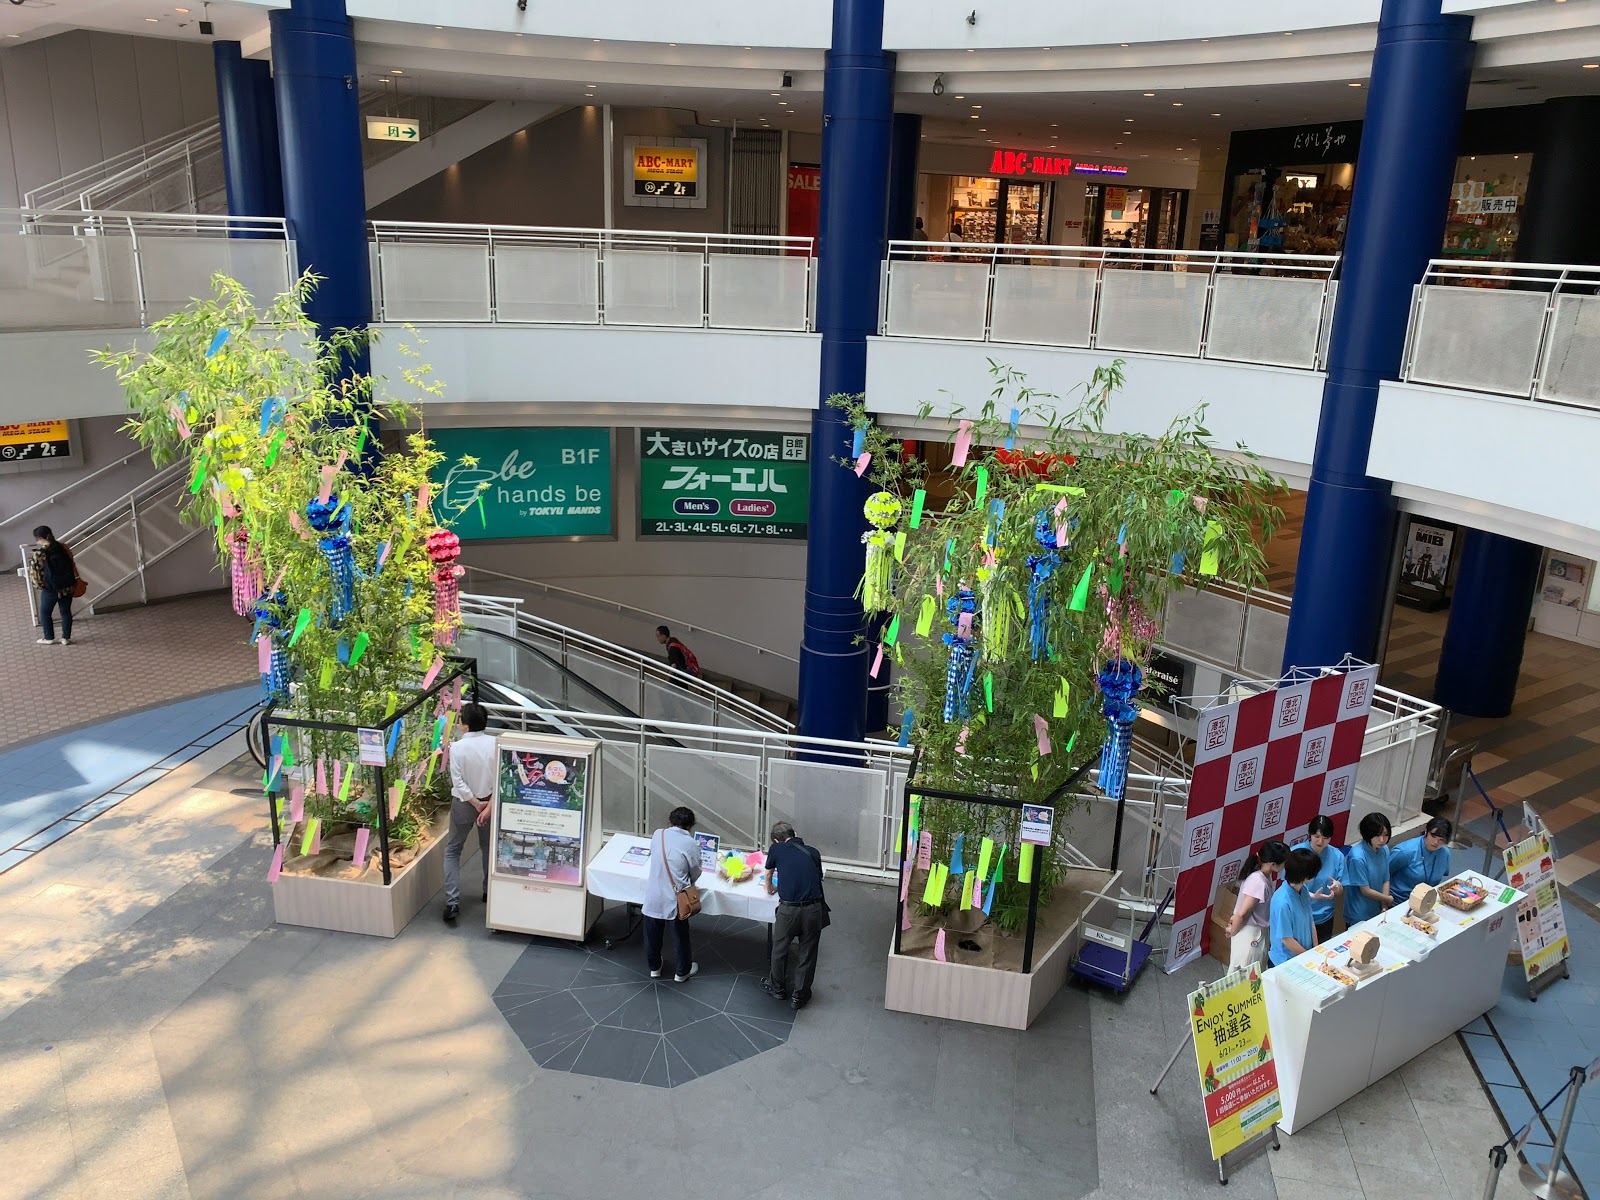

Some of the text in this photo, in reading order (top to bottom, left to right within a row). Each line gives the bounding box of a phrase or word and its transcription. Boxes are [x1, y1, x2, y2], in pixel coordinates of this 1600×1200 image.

[637, 155, 694, 168] ABC-MART
[990, 150, 1072, 175] ABC-MART
[673, 182, 686, 195] 2F
[41, 442, 57, 456] 2F
[646, 431, 780, 460] 大きいサイズの店
[561, 448, 601, 465] B1F
[661, 466, 789, 493] フォーエル
[497, 485, 602, 503] hands be
[519, 506, 602, 517] by TOKYU HANDS
[683, 501, 711, 511] Men's
[737, 503, 770, 513] Ladies'
[1415, 531, 1445, 546] MIB
[1196, 993, 1263, 1033] ENJOY SUMMER
[1213, 1013, 1252, 1047] 抽選会
